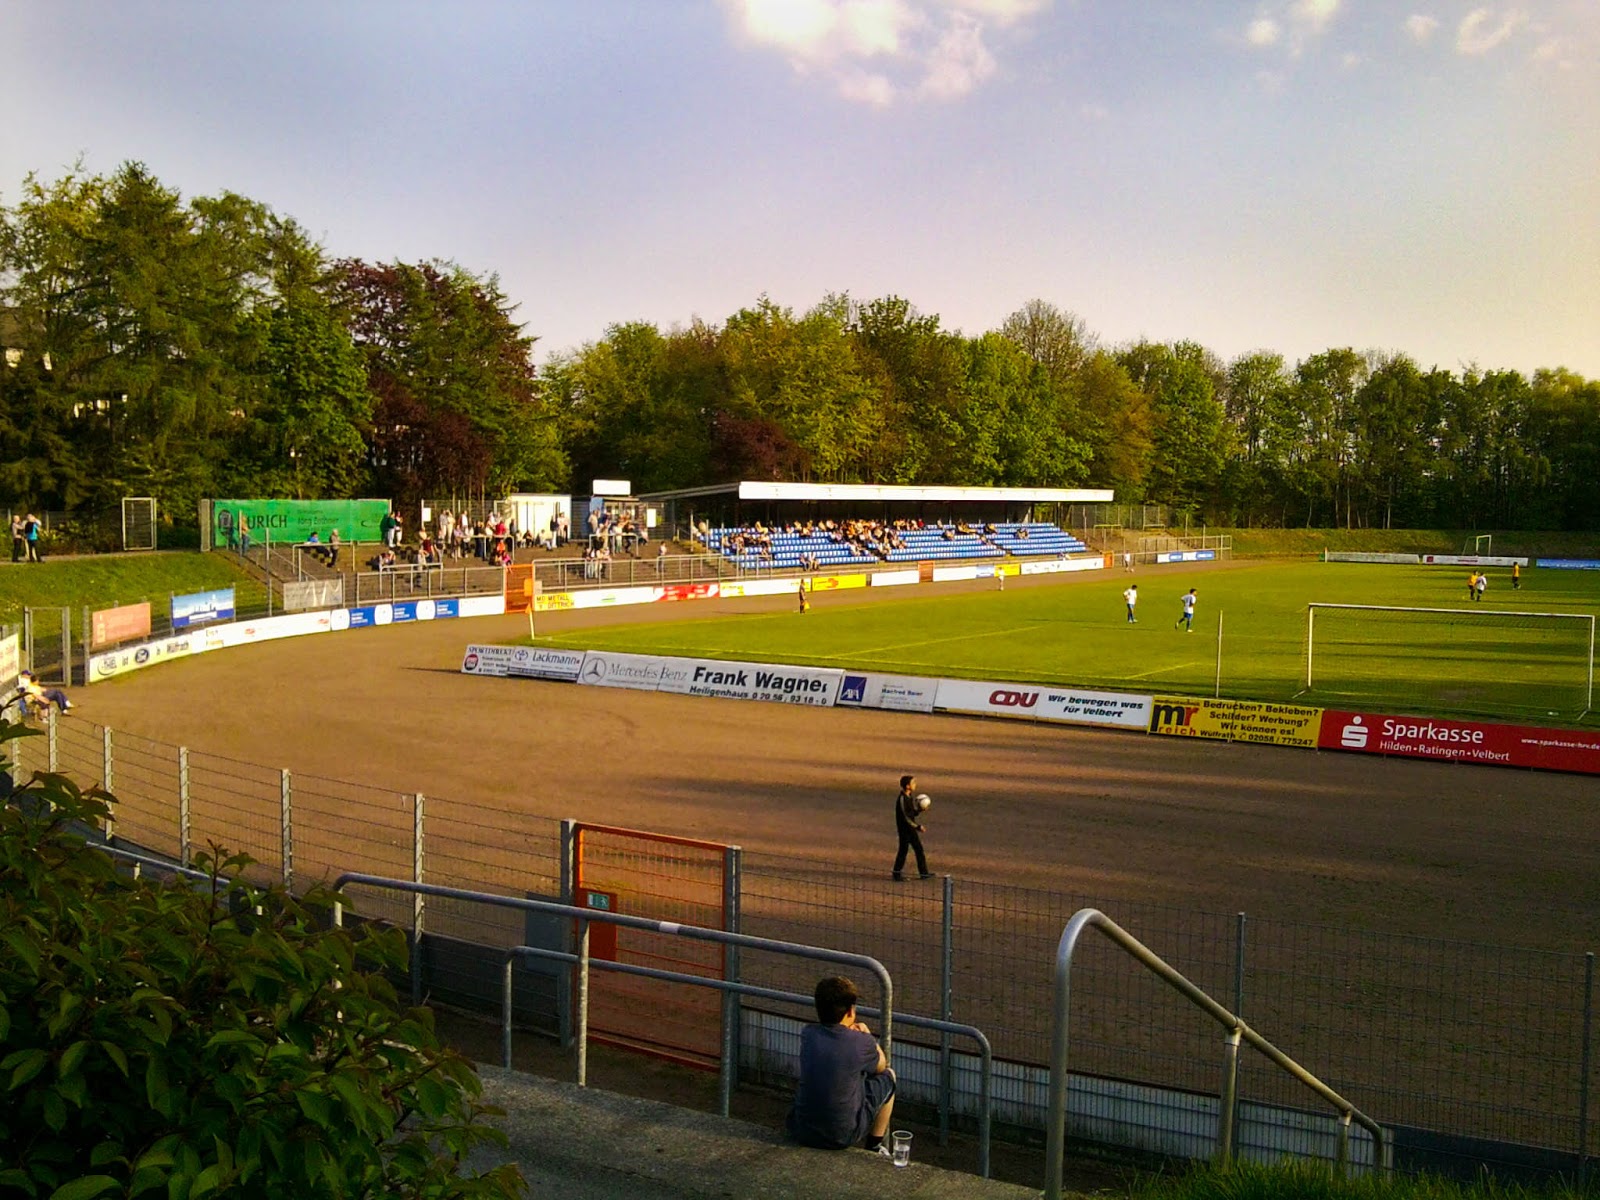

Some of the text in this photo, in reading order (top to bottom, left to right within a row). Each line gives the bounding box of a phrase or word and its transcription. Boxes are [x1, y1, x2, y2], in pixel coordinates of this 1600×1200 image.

[245, 514, 288, 530] URICH
[532, 650, 577, 665] Lackmann
[607, 662, 658, 680] Mercedes
[692, 666, 749, 687] Frank
[755, 671, 828, 694] Wagner
[689, 685, 749, 699] Heiligenhaus
[841, 687, 859, 700] AXA
[988, 690, 1039, 708] CDU
[1048, 694, 1144, 711] Wir bewegen was
[1203, 700, 1319, 717] Bedrucken? Bekleben?
[1063, 704, 1124, 719] für Velbert
[1209, 711, 1309, 728] Schilder? Werbung?
[1158, 726, 1197, 737] reich
[1220, 722, 1295, 737] Wir können es!
[1381, 719, 1484, 744] Sparkasse
[1379, 741, 1510, 762] Hilden Ratingen Velbert
